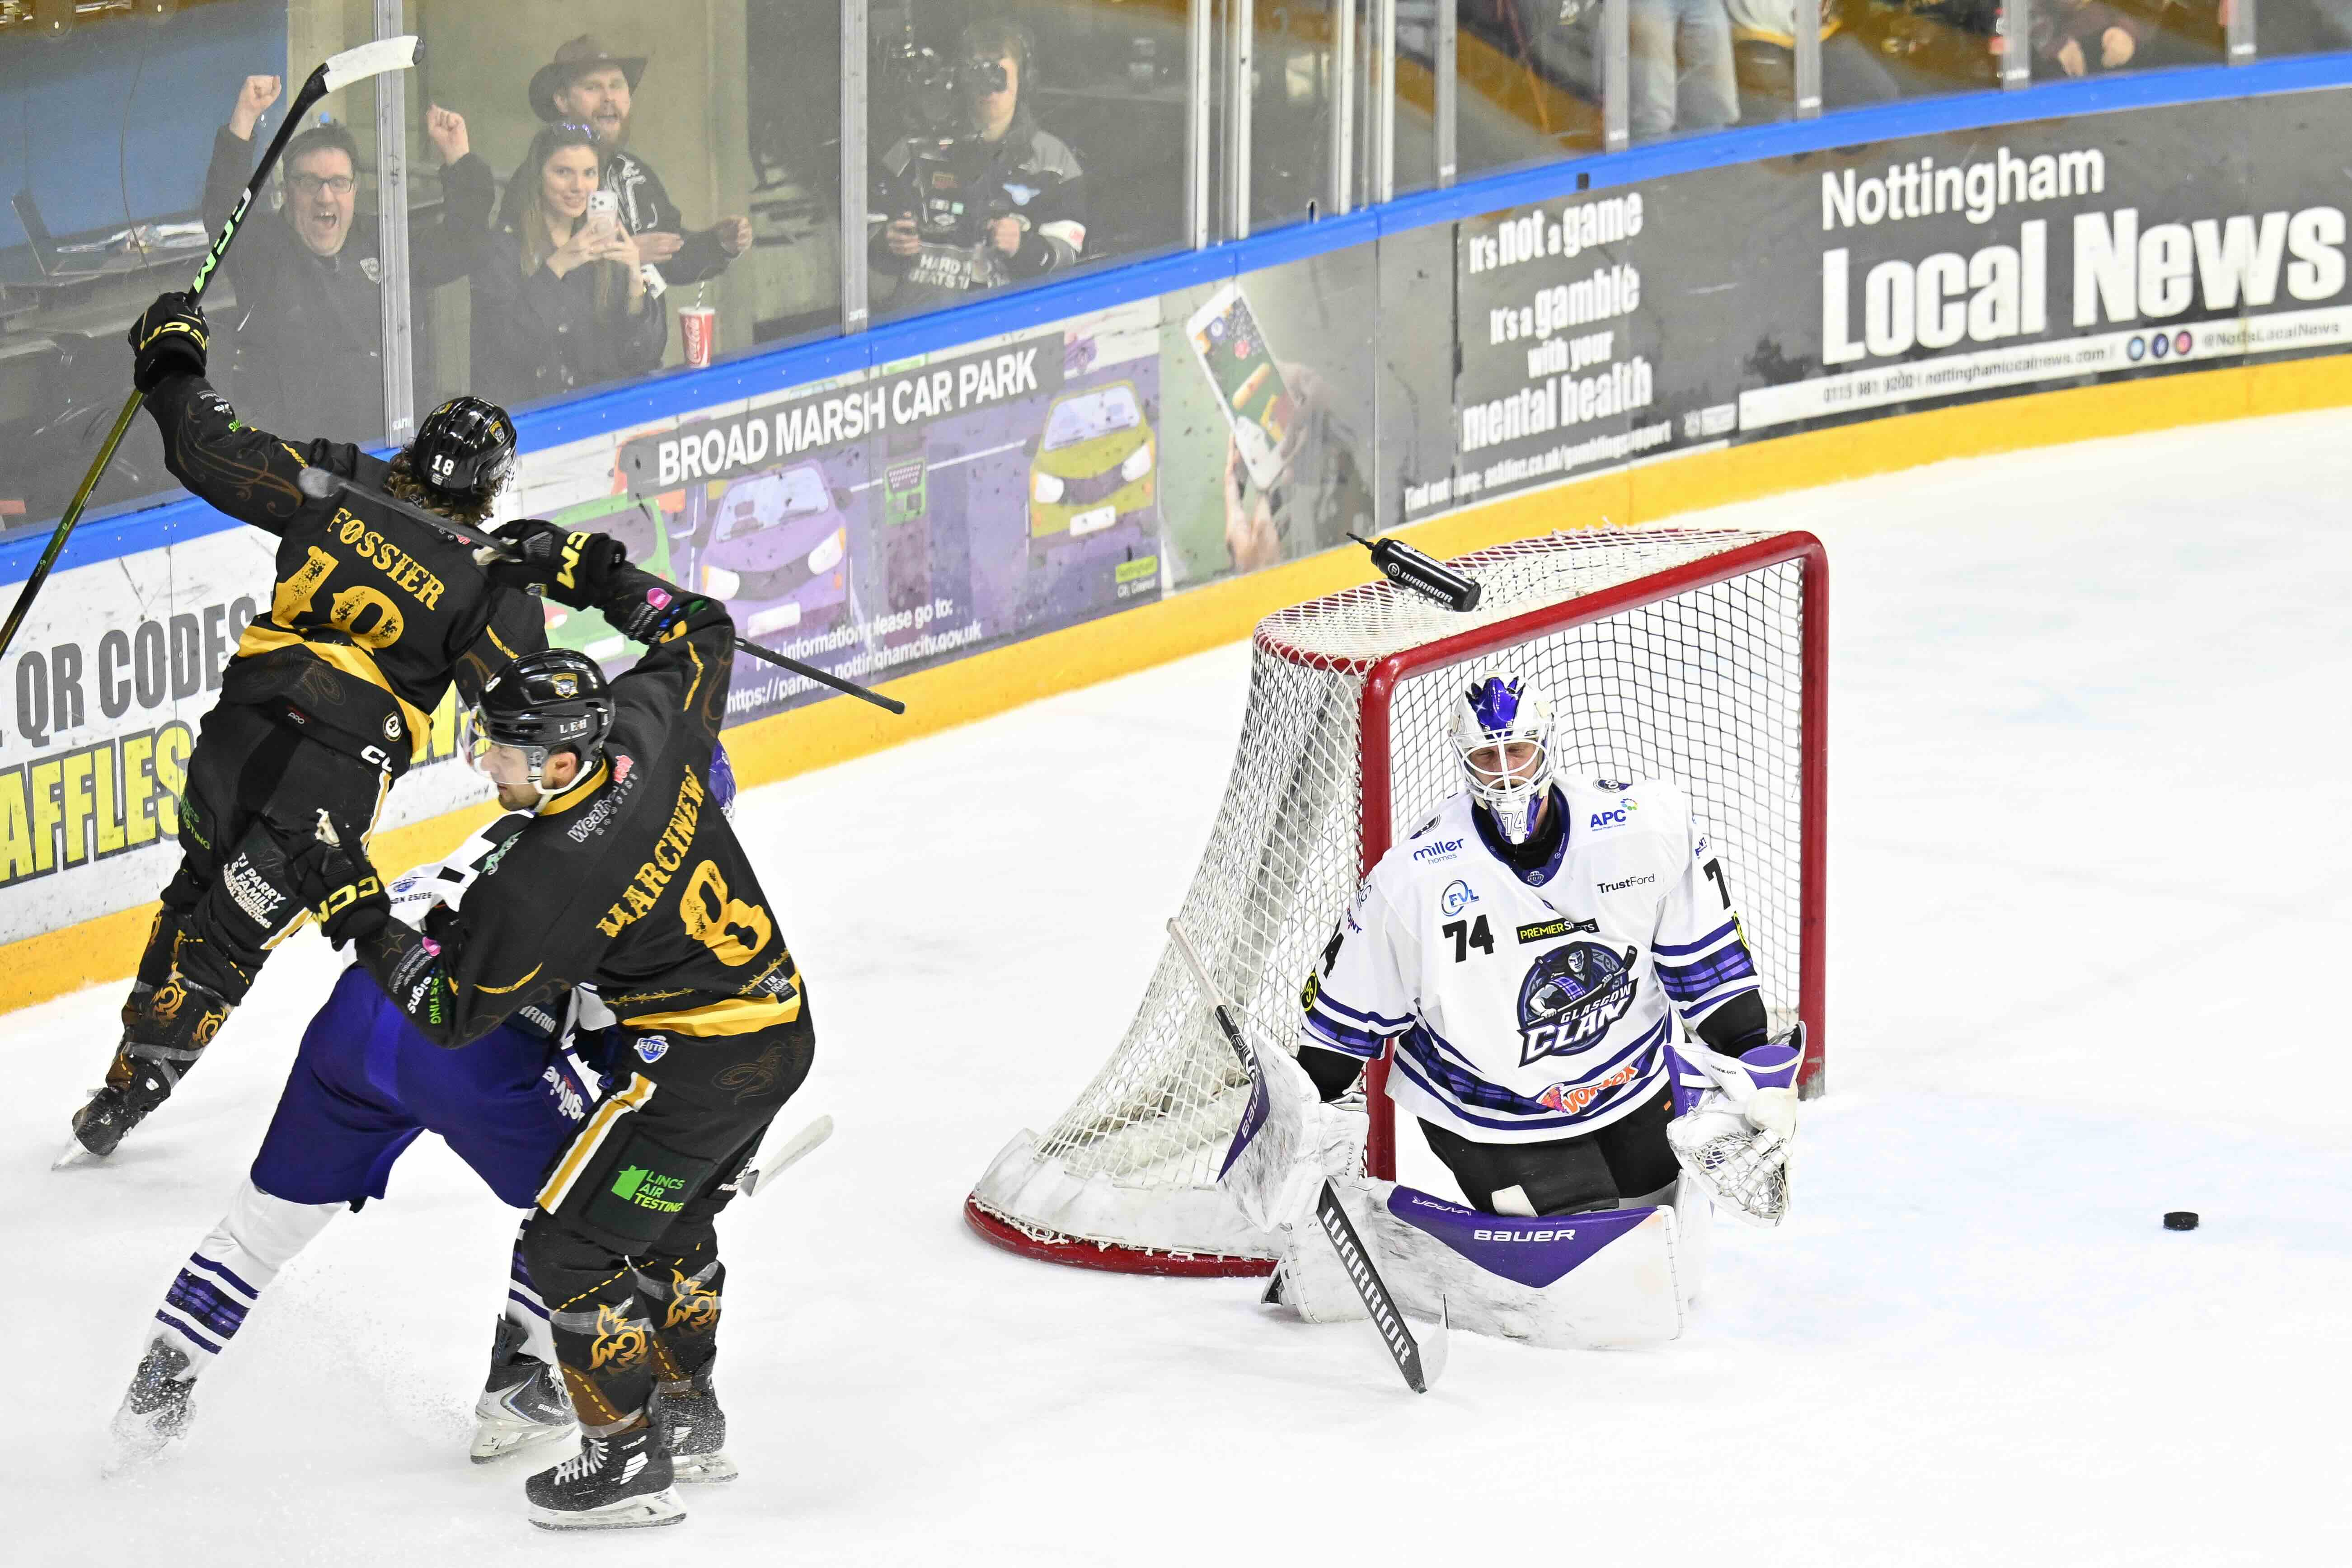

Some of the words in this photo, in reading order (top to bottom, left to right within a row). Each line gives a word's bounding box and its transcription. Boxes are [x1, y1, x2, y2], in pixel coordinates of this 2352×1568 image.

[1822, 147, 2104, 230] Nottingham
[192, 188, 252, 293] CCM
[1499, 209, 1545, 266] not
[1548, 225, 1561, 255] a
[1563, 192, 1643, 257] game
[1520, 307, 1533, 337] a
[1535, 263, 1640, 339] gamble
[1822, 219, 2047, 365] Local
[2073, 207, 2347, 327] News
[1527, 337, 1569, 379] with
[1570, 331, 1614, 372] your
[659, 419, 768, 487] BROAD
[776, 386, 885, 456] MARSH
[892, 370, 952, 424] CAR
[959, 347, 1038, 408] PARK
[1463, 377, 1557, 452] mental
[1561, 355, 1653, 426] health
[432, 454, 454, 475] 18
[327, 507, 445, 611] FOSSIER
[272, 545, 404, 656] 10
[1401, 572, 1453, 602] WARRIOR
[915, 605, 933, 629] go
[934, 597, 953, 618] to:
[16, 643, 85, 747] QR
[1500, 810, 1527, 837] 74
[1590, 809, 1626, 828] APC
[1413, 838, 1464, 861] miller
[1427, 852, 1458, 864] homes
[236, 873, 279, 912] FAMILY
[238, 852, 249, 867] TJ
[245, 867, 286, 902] PARRY
[1597, 873, 1655, 893] TrustFord
[235, 896, 272, 929] DIRECTORS
[680, 859, 771, 966] 8
[1448, 889, 1479, 906] FVL
[1442, 914, 1494, 963] 74
[1520, 923, 1564, 940] PREMIER
[1560, 982, 1632, 1023] GLASGOW
[1525, 996, 1629, 1061] CLAN
[638, 1183, 665, 1198] AIR
[646, 1171, 686, 1190] LINCS
[634, 1192, 685, 1213] TESTING
[1413, 1196, 1472, 1216] VAPOR
[1474, 1229, 1576, 1242] BAUER
[1323, 1207, 1411, 1365] WARRIOR
